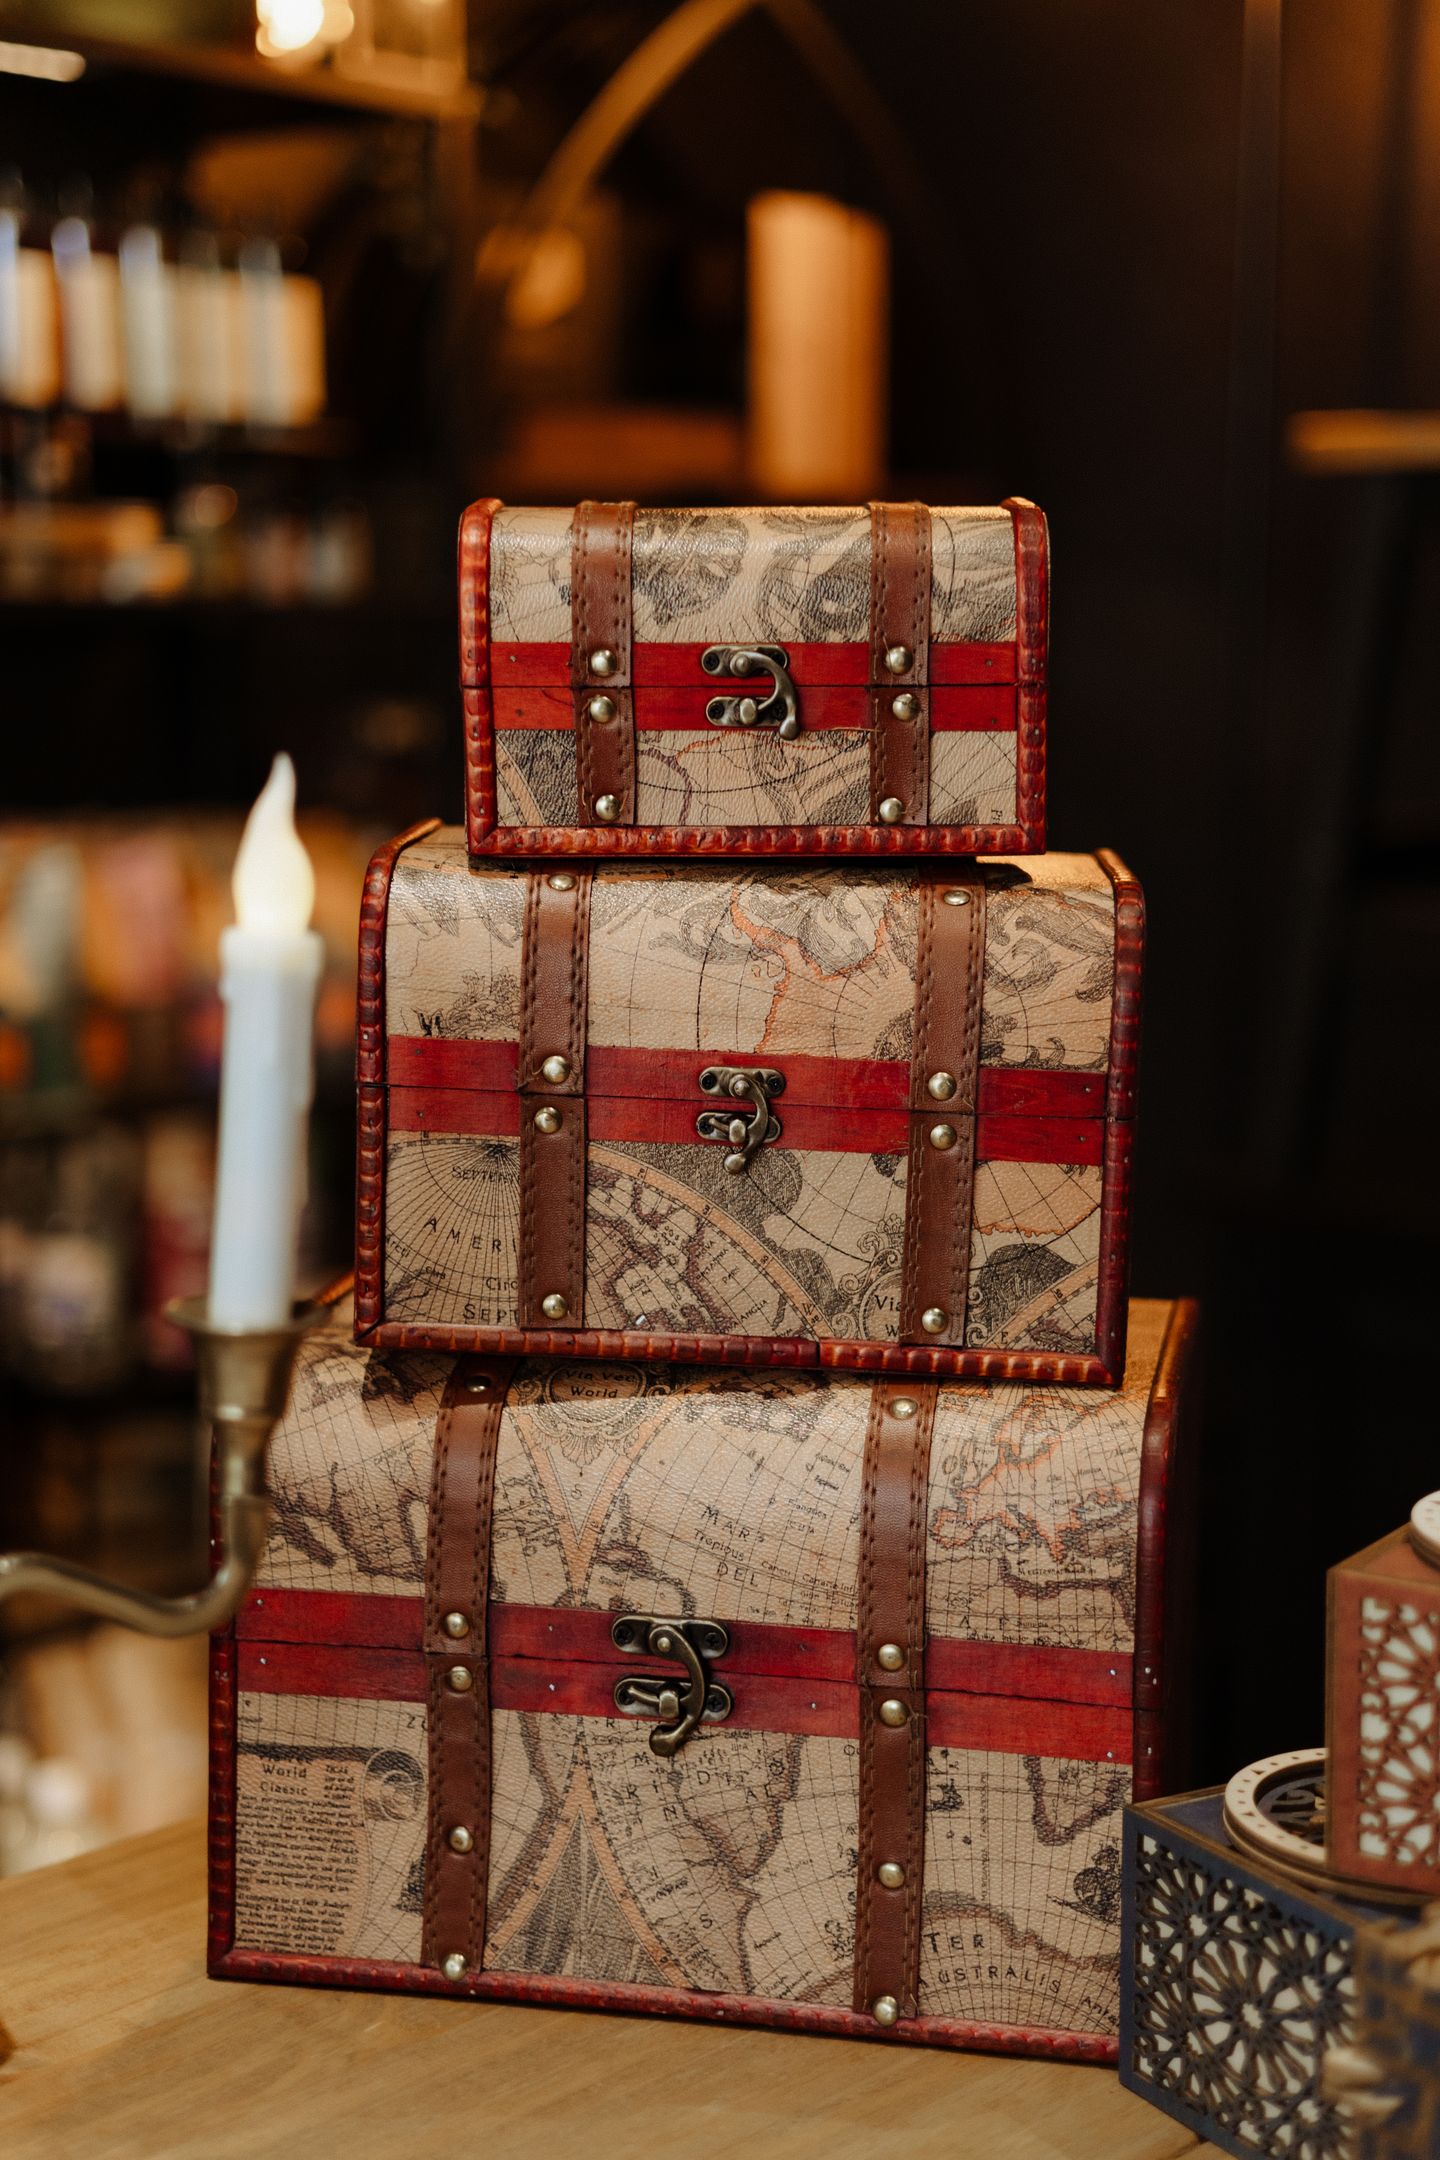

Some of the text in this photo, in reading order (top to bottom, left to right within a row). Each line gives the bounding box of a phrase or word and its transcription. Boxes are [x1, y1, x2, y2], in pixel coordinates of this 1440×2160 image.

[570, 1385, 619, 1398] World
[262, 1764, 308, 1779] World
[260, 1781, 308, 1796] Classic
